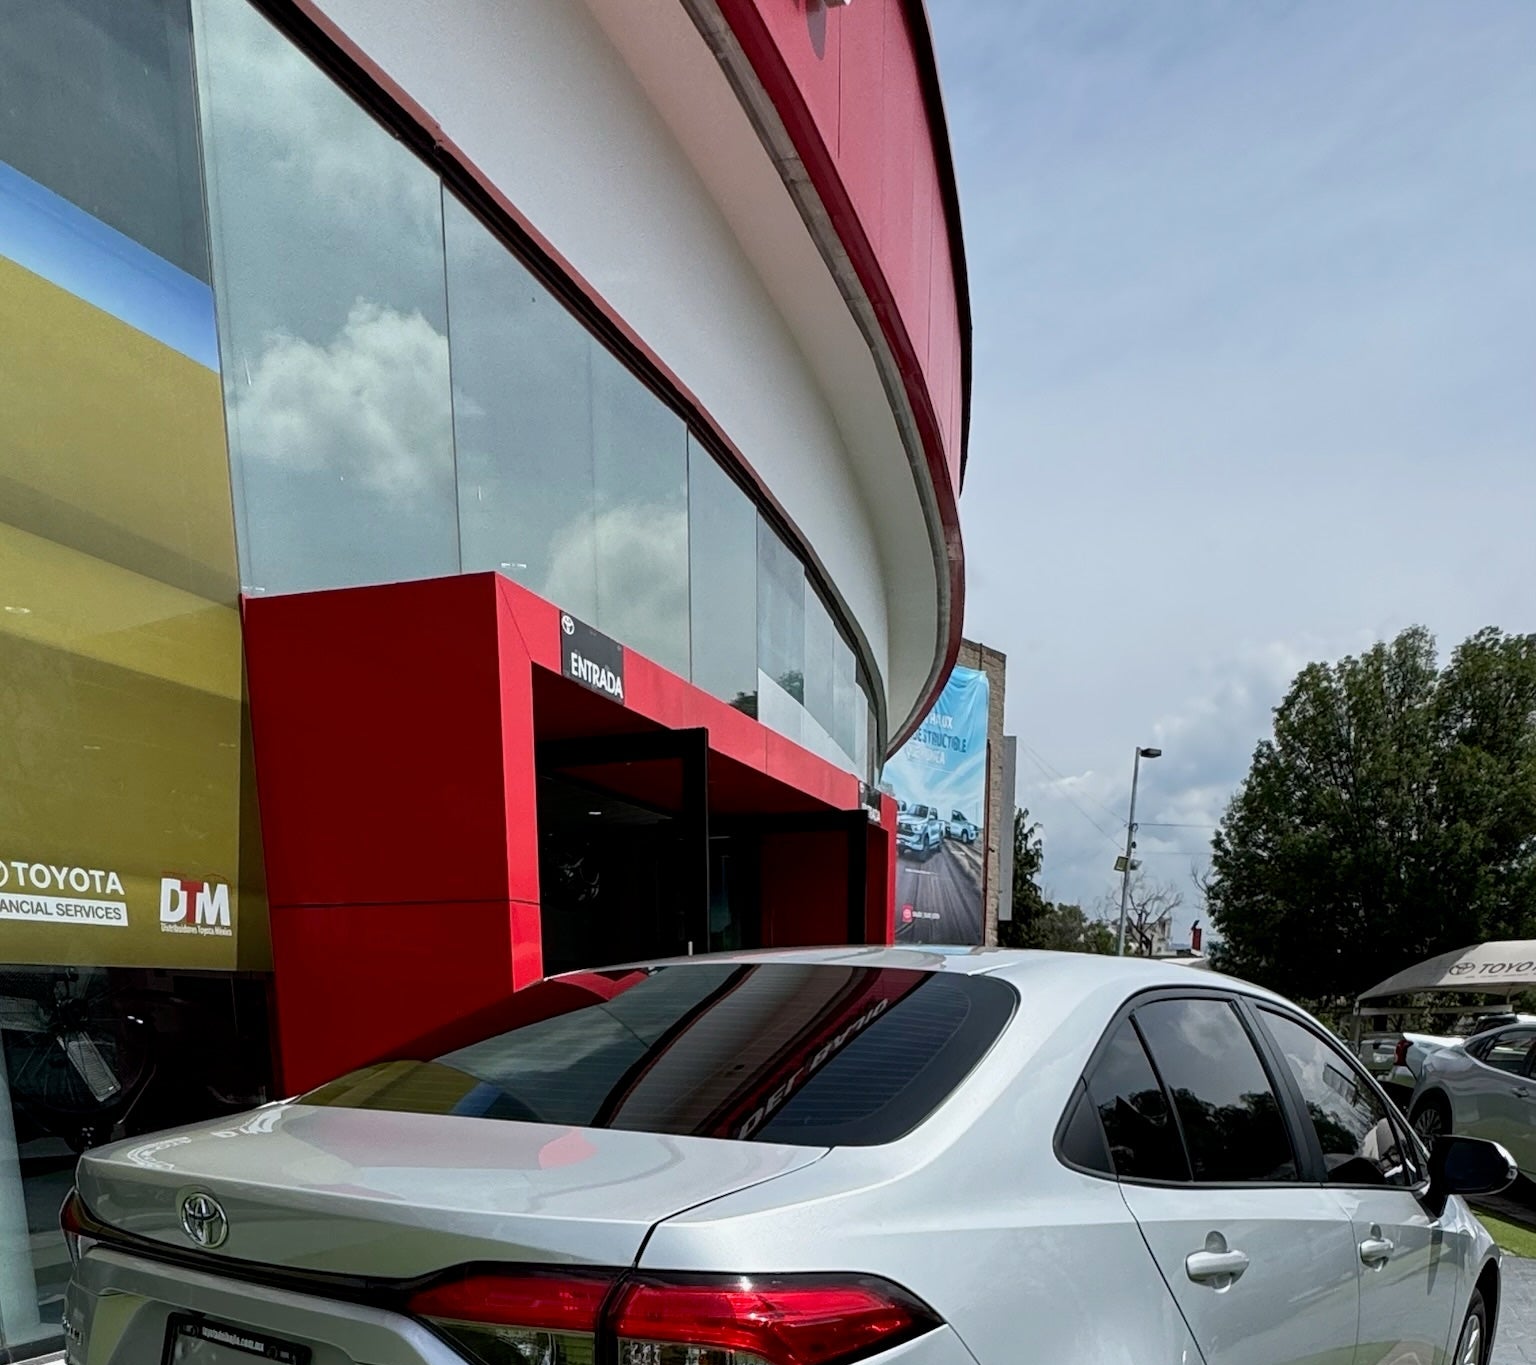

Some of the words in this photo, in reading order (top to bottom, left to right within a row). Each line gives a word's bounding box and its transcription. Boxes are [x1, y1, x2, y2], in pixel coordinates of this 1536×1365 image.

[570, 651, 624, 700] ENTRADA
[10, 861, 125, 896] TOYOTA
[55, 903, 122, 920] SERVICES
[160, 877, 231, 927] DTM
[1478, 961, 1536, 974] TOYO
